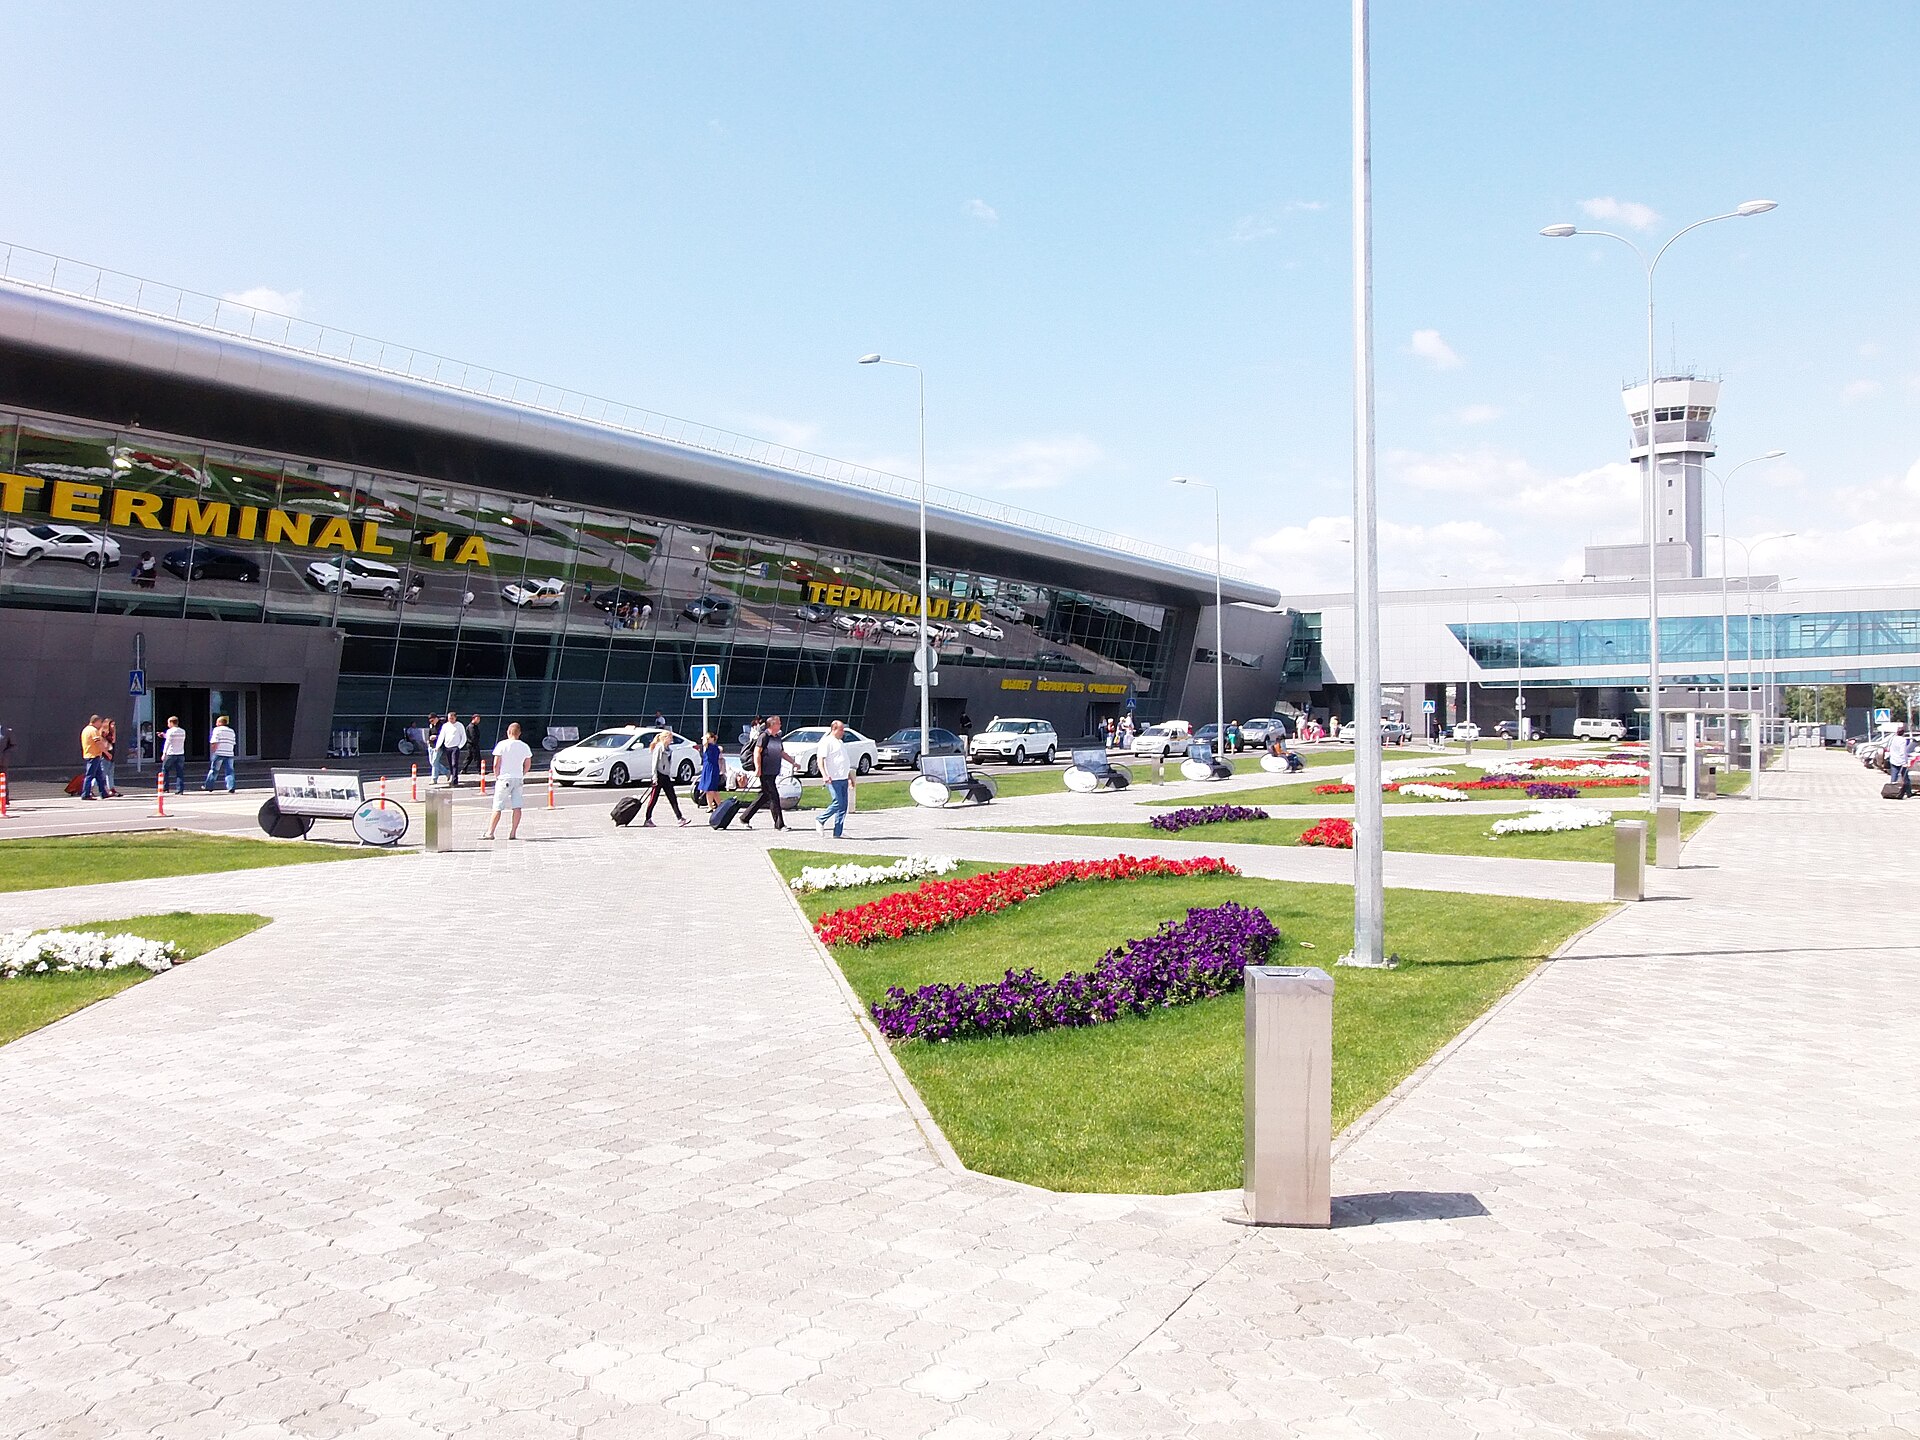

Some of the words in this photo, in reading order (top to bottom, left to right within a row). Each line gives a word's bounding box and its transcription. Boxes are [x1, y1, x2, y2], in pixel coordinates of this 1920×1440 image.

[0, 471, 394, 556] TERMINAL
[424, 531, 490, 567] 1A
[807, 581, 949, 619] ТЕРМИНАЛ
